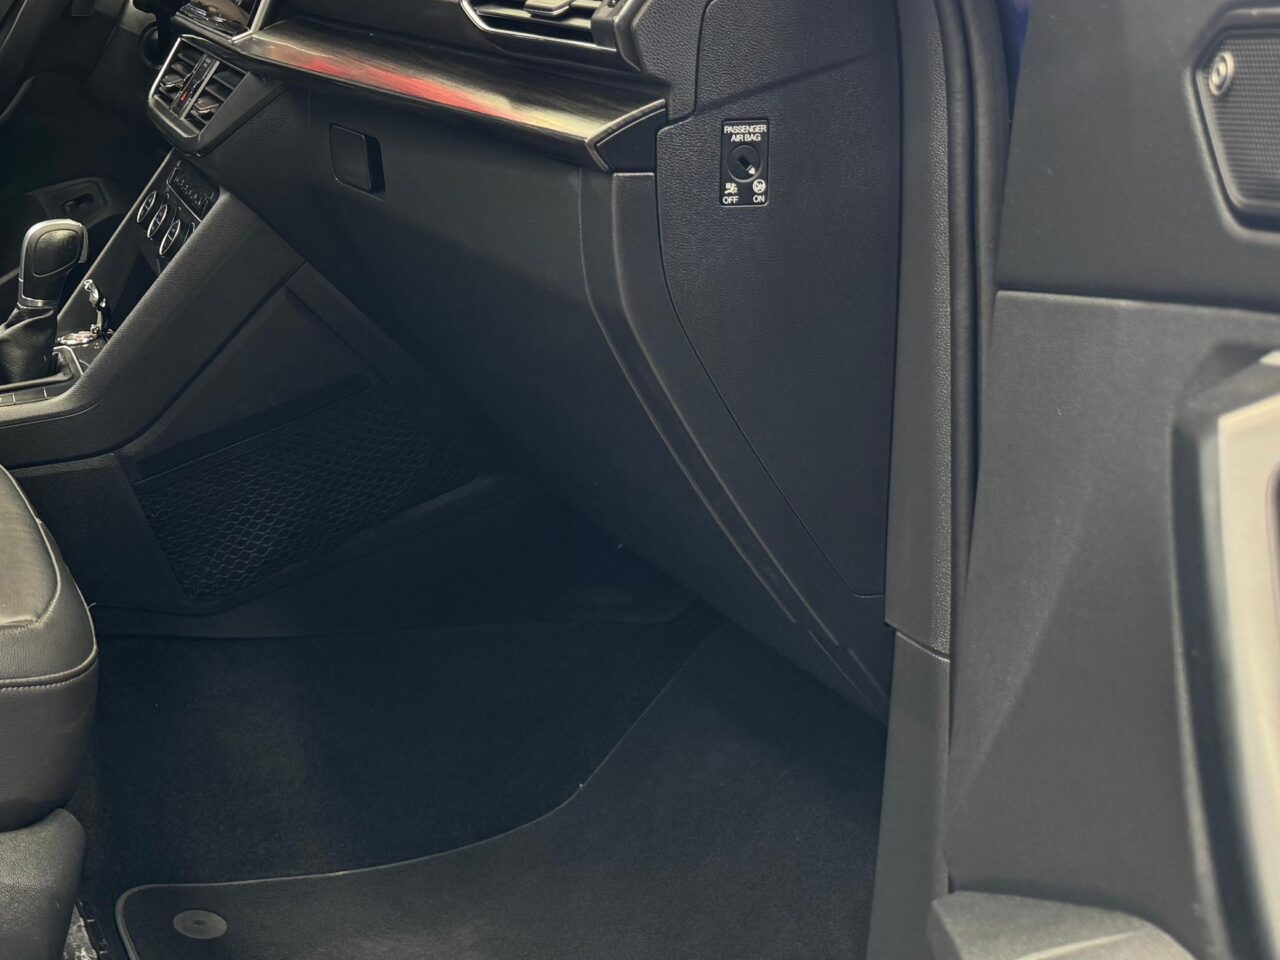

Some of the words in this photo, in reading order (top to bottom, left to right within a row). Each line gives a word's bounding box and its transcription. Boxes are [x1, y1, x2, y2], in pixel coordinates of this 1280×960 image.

[723, 124, 767, 134] PASSENGER
[722, 196, 739, 204] OFF
[752, 195, 765, 203] ON
